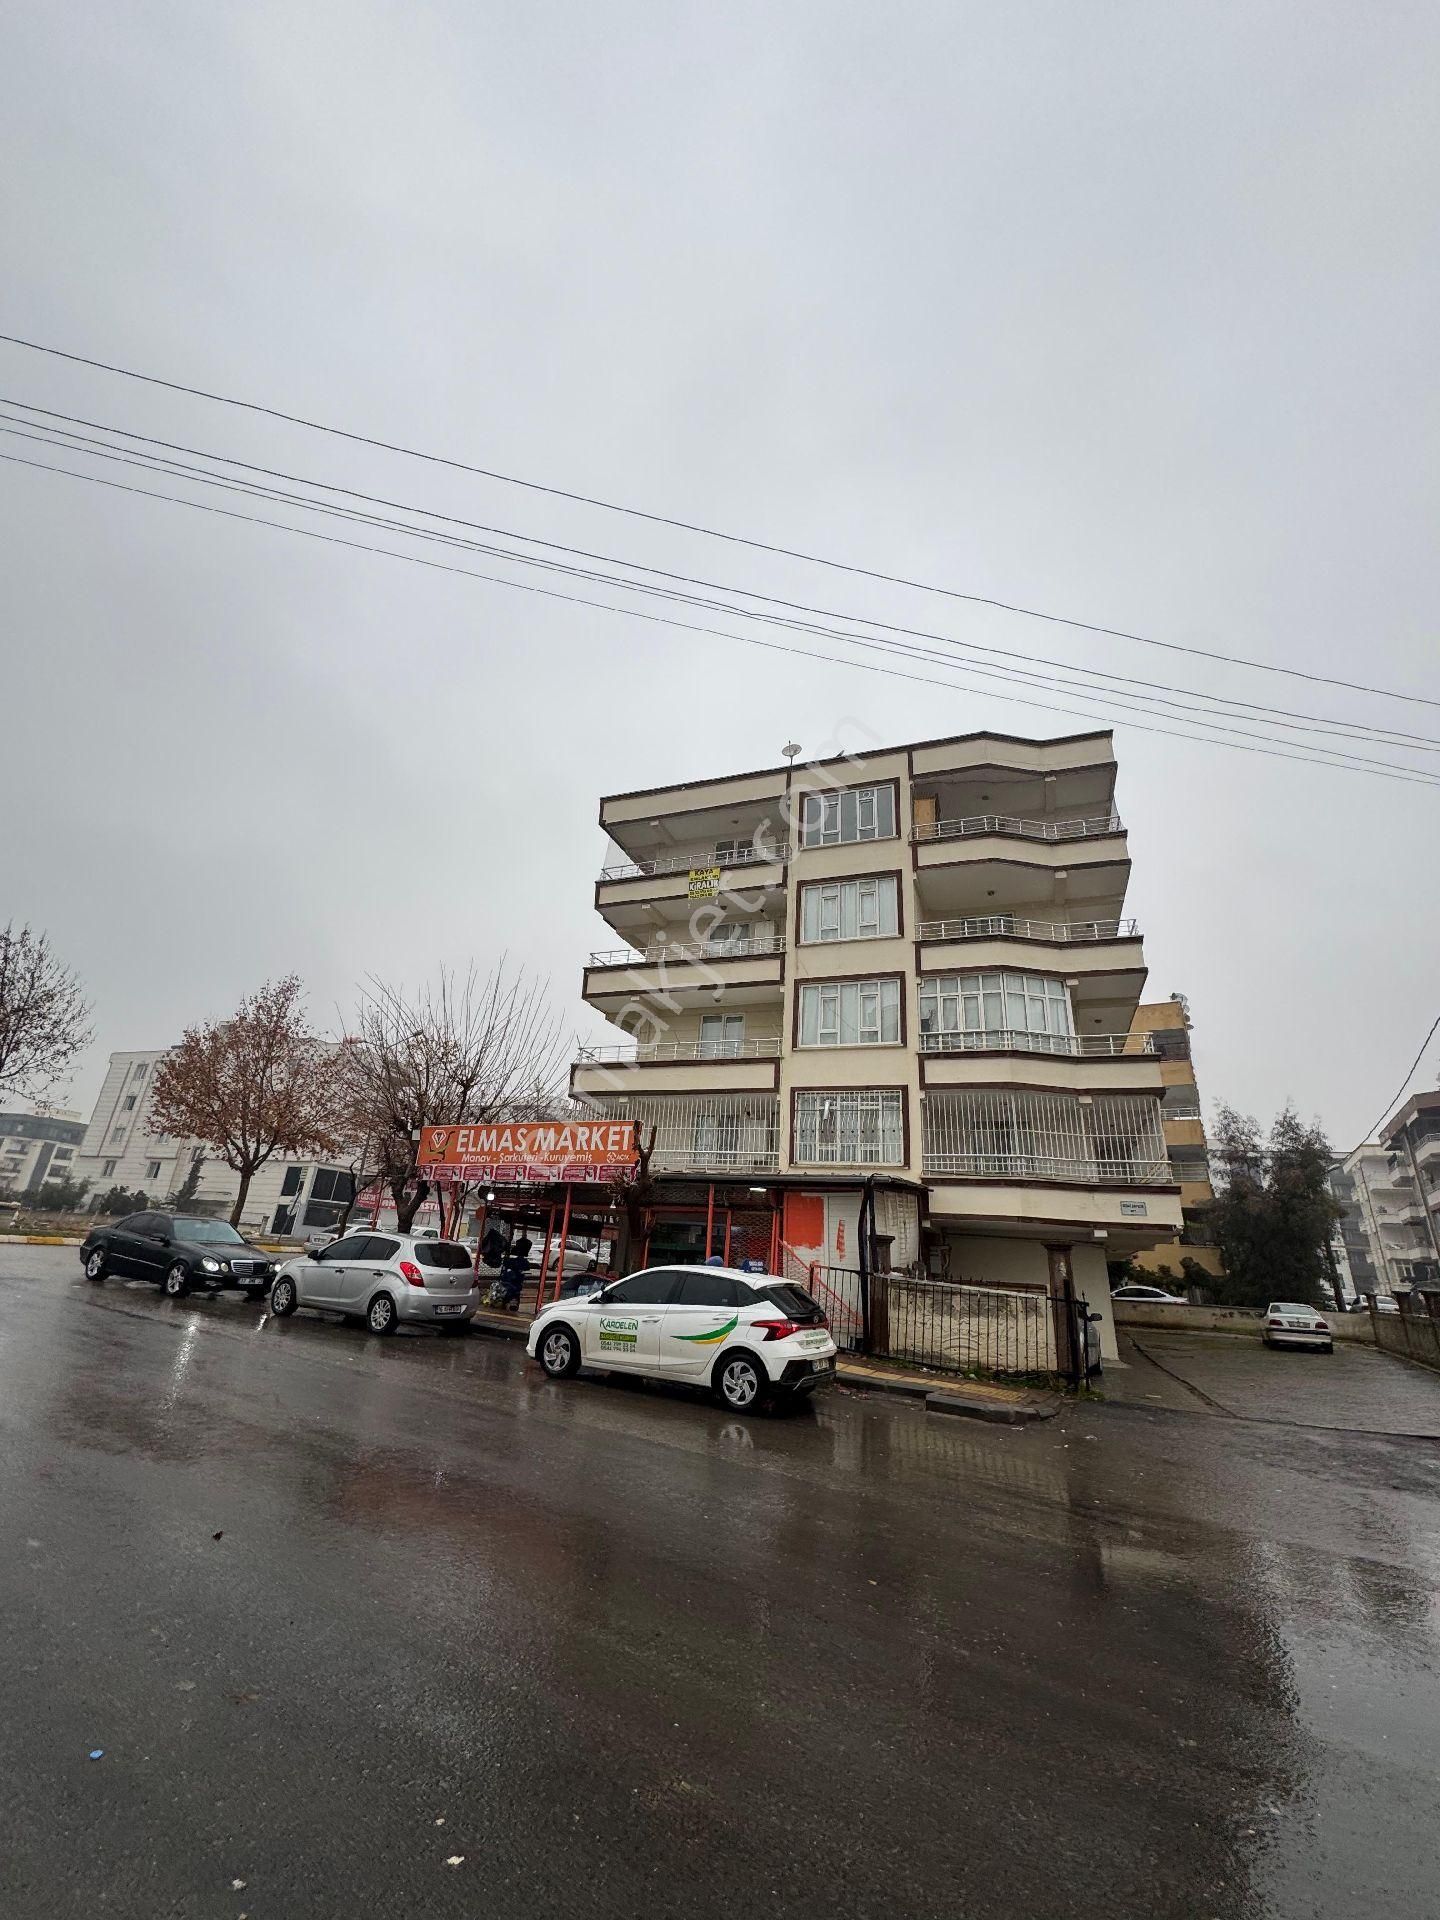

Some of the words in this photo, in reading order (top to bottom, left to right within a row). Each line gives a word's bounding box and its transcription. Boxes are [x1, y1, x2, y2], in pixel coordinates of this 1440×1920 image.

[456, 1128, 528, 1152] ELMAS
[533, 1126, 633, 1151] MARKET
[461, 1153, 491, 1163] Manav
[500, 1151, 538, 1164] Şarküteri
[600, 1317, 638, 1331] KARDELEN
